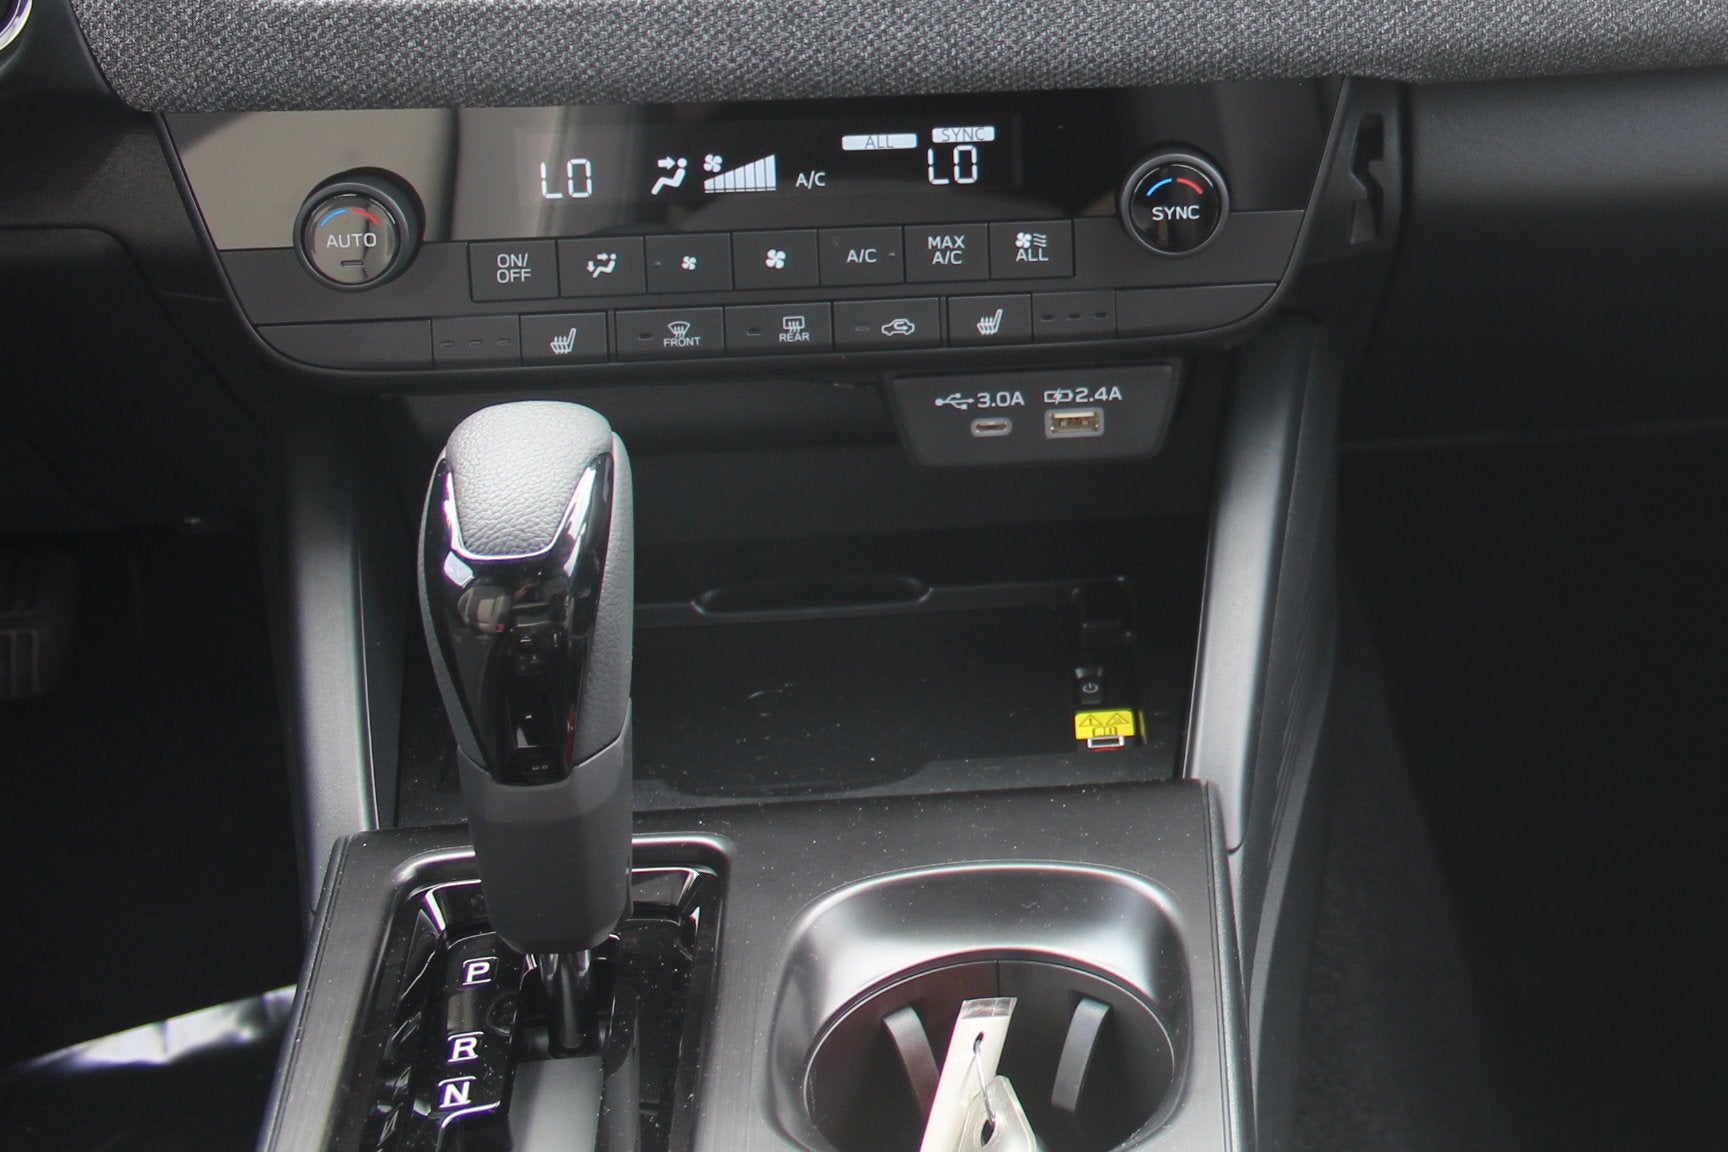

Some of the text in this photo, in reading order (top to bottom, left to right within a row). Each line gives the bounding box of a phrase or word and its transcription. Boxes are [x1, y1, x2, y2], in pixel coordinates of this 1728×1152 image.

[864, 134, 895, 150] ALL
[941, 126, 986, 142] SYNC
[796, 171, 826, 189] A/C
[1151, 204, 1200, 221] SYNC
[326, 232, 377, 248] AUTO
[928, 235, 965, 250] MAX
[497, 252, 529, 268] ON/
[846, 248, 877, 265] A/C
[932, 249, 963, 266] A/C
[1016, 248, 1049, 263] ALL
[496, 267, 532, 284] OFF
[663, 336, 701, 348] FRONT
[778, 330, 810, 343] REAR
[977, 391, 1025, 408] 3.0A
[1075, 386, 1123, 403] 2.4A
[466, 963, 491, 983] P
[452, 1038, 478, 1059] R
[443, 1082, 471, 1106] N
